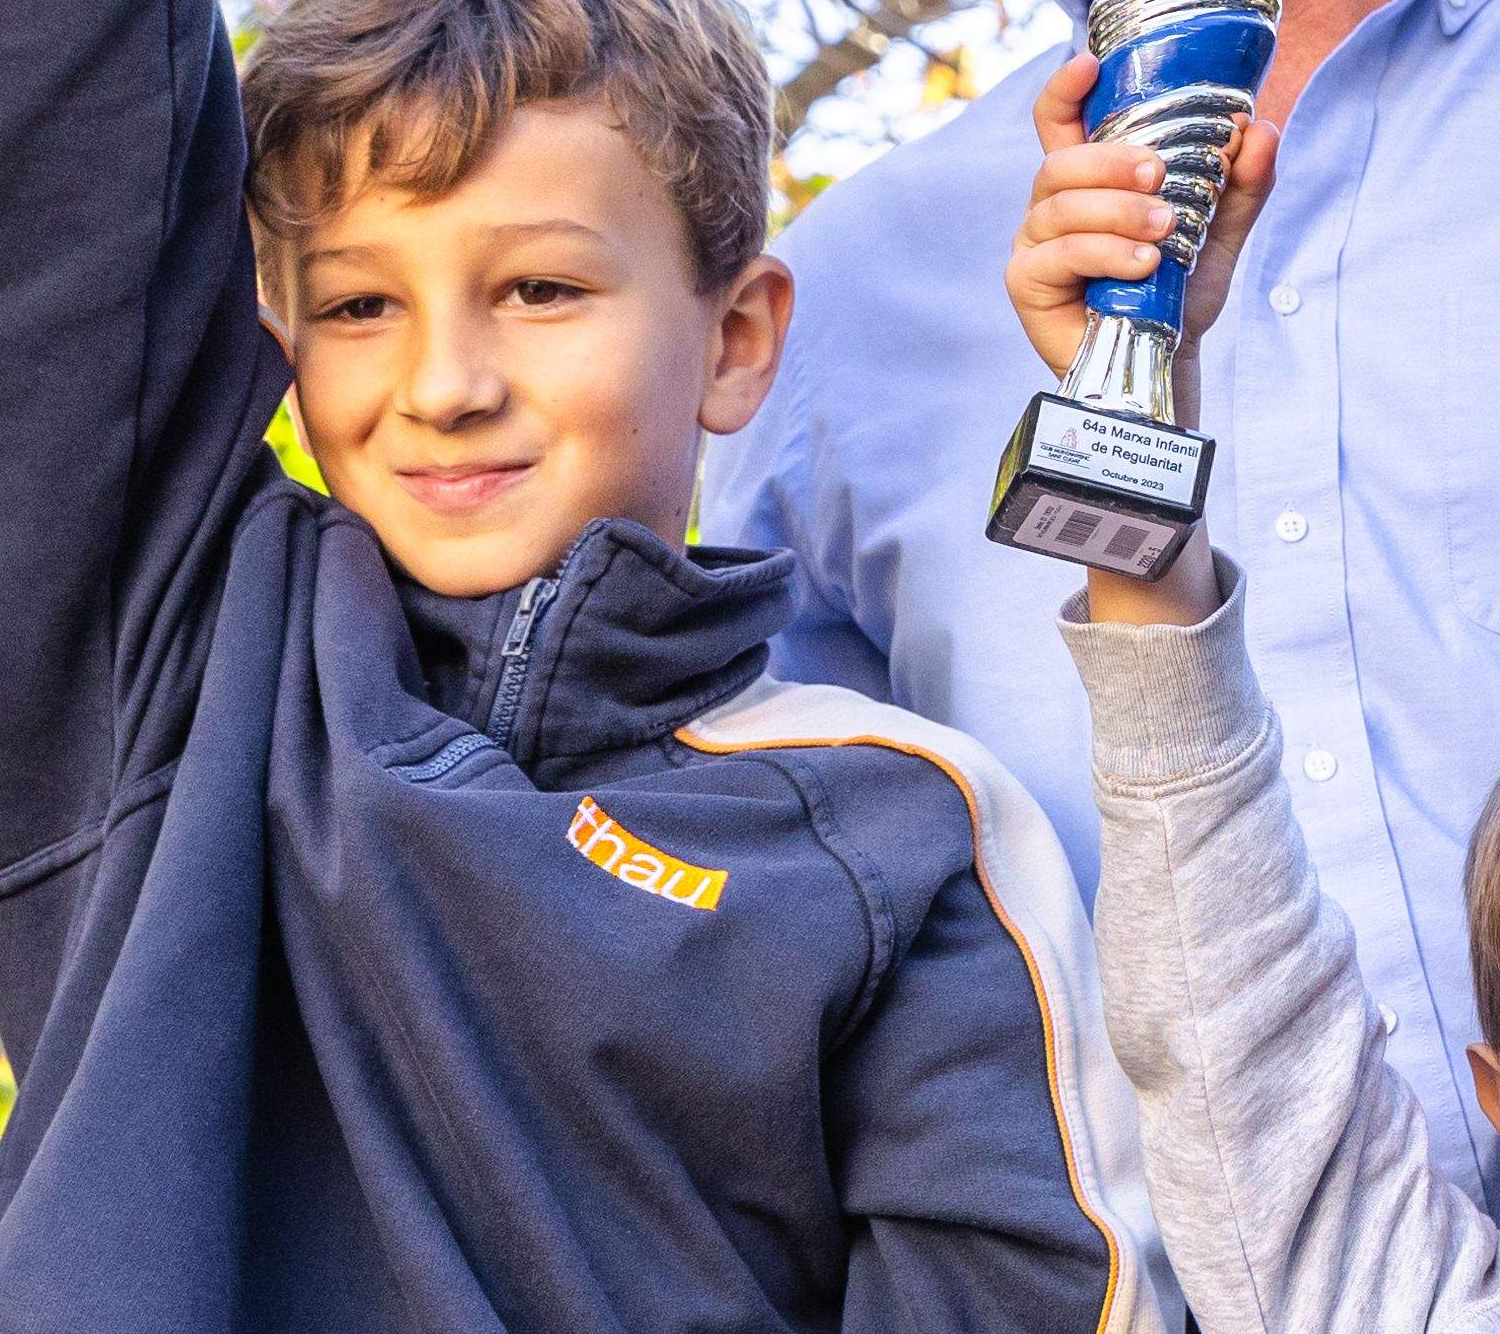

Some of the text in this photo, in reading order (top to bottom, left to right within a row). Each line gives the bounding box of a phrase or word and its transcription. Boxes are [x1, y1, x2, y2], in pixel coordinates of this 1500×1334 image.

[1082, 419, 1199, 458] 64a Marxa Infantil
[1091, 441, 1108, 454] de
[1111, 445, 1183, 474] Regularitat
[1101, 468, 1165, 491] Octubre 2023
[566, 801, 712, 909] thau
